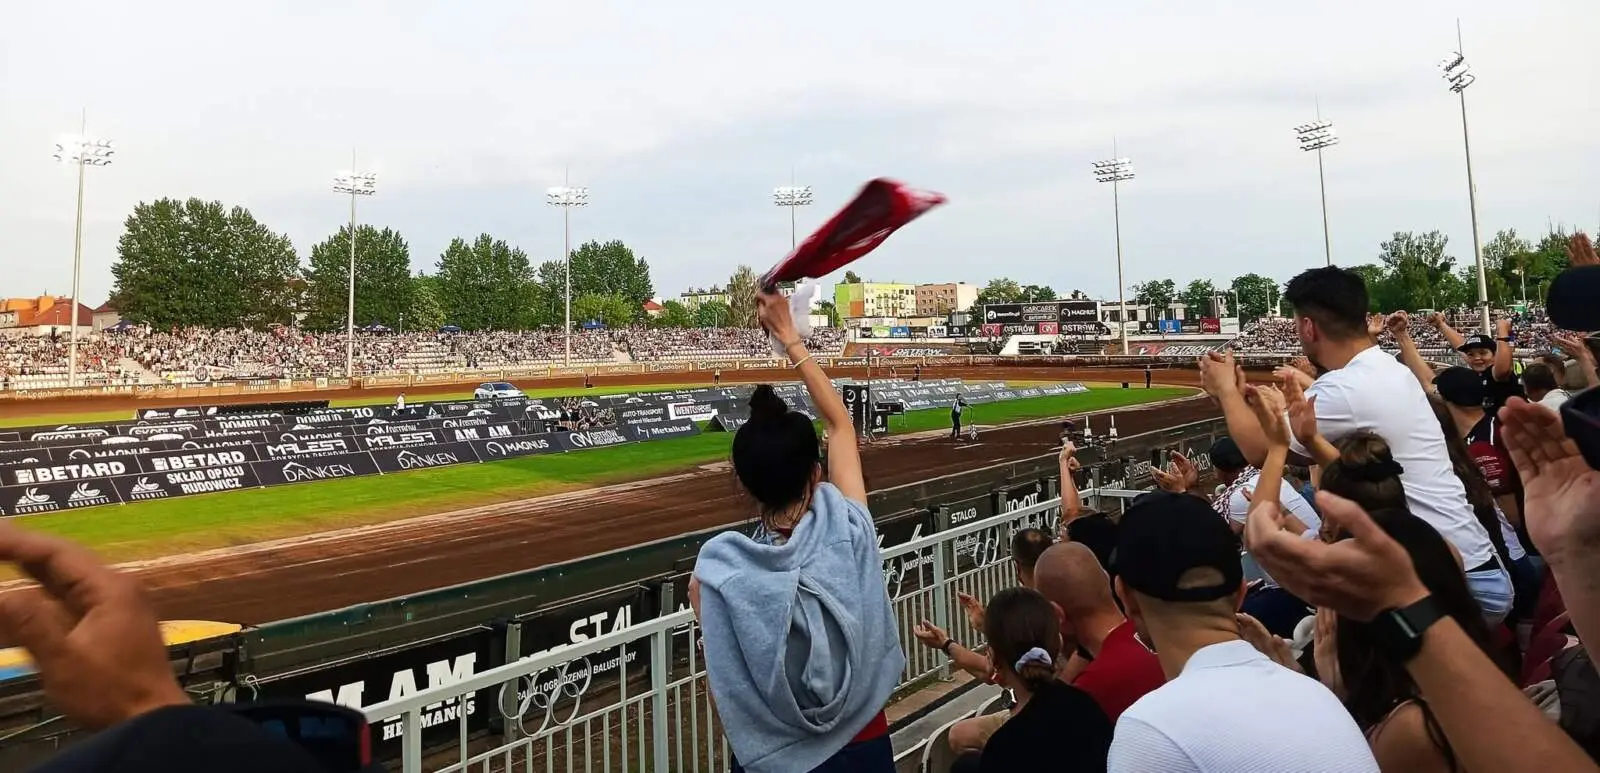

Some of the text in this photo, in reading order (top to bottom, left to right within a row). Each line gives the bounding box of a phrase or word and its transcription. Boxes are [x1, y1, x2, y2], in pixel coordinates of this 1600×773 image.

[455, 425, 513, 441] AM AM
[504, 439, 549, 452] MAGNUS
[168, 451, 246, 471] BETARD
[397, 451, 459, 469] DANKEN
[36, 461, 126, 483] BETARD
[166, 466, 245, 484] SKŁAD OPAŁU
[282, 463, 355, 482] DANKEN
[181, 478, 243, 495] RUDOWICZ
[593, 652, 637, 674] BALUSTADY
